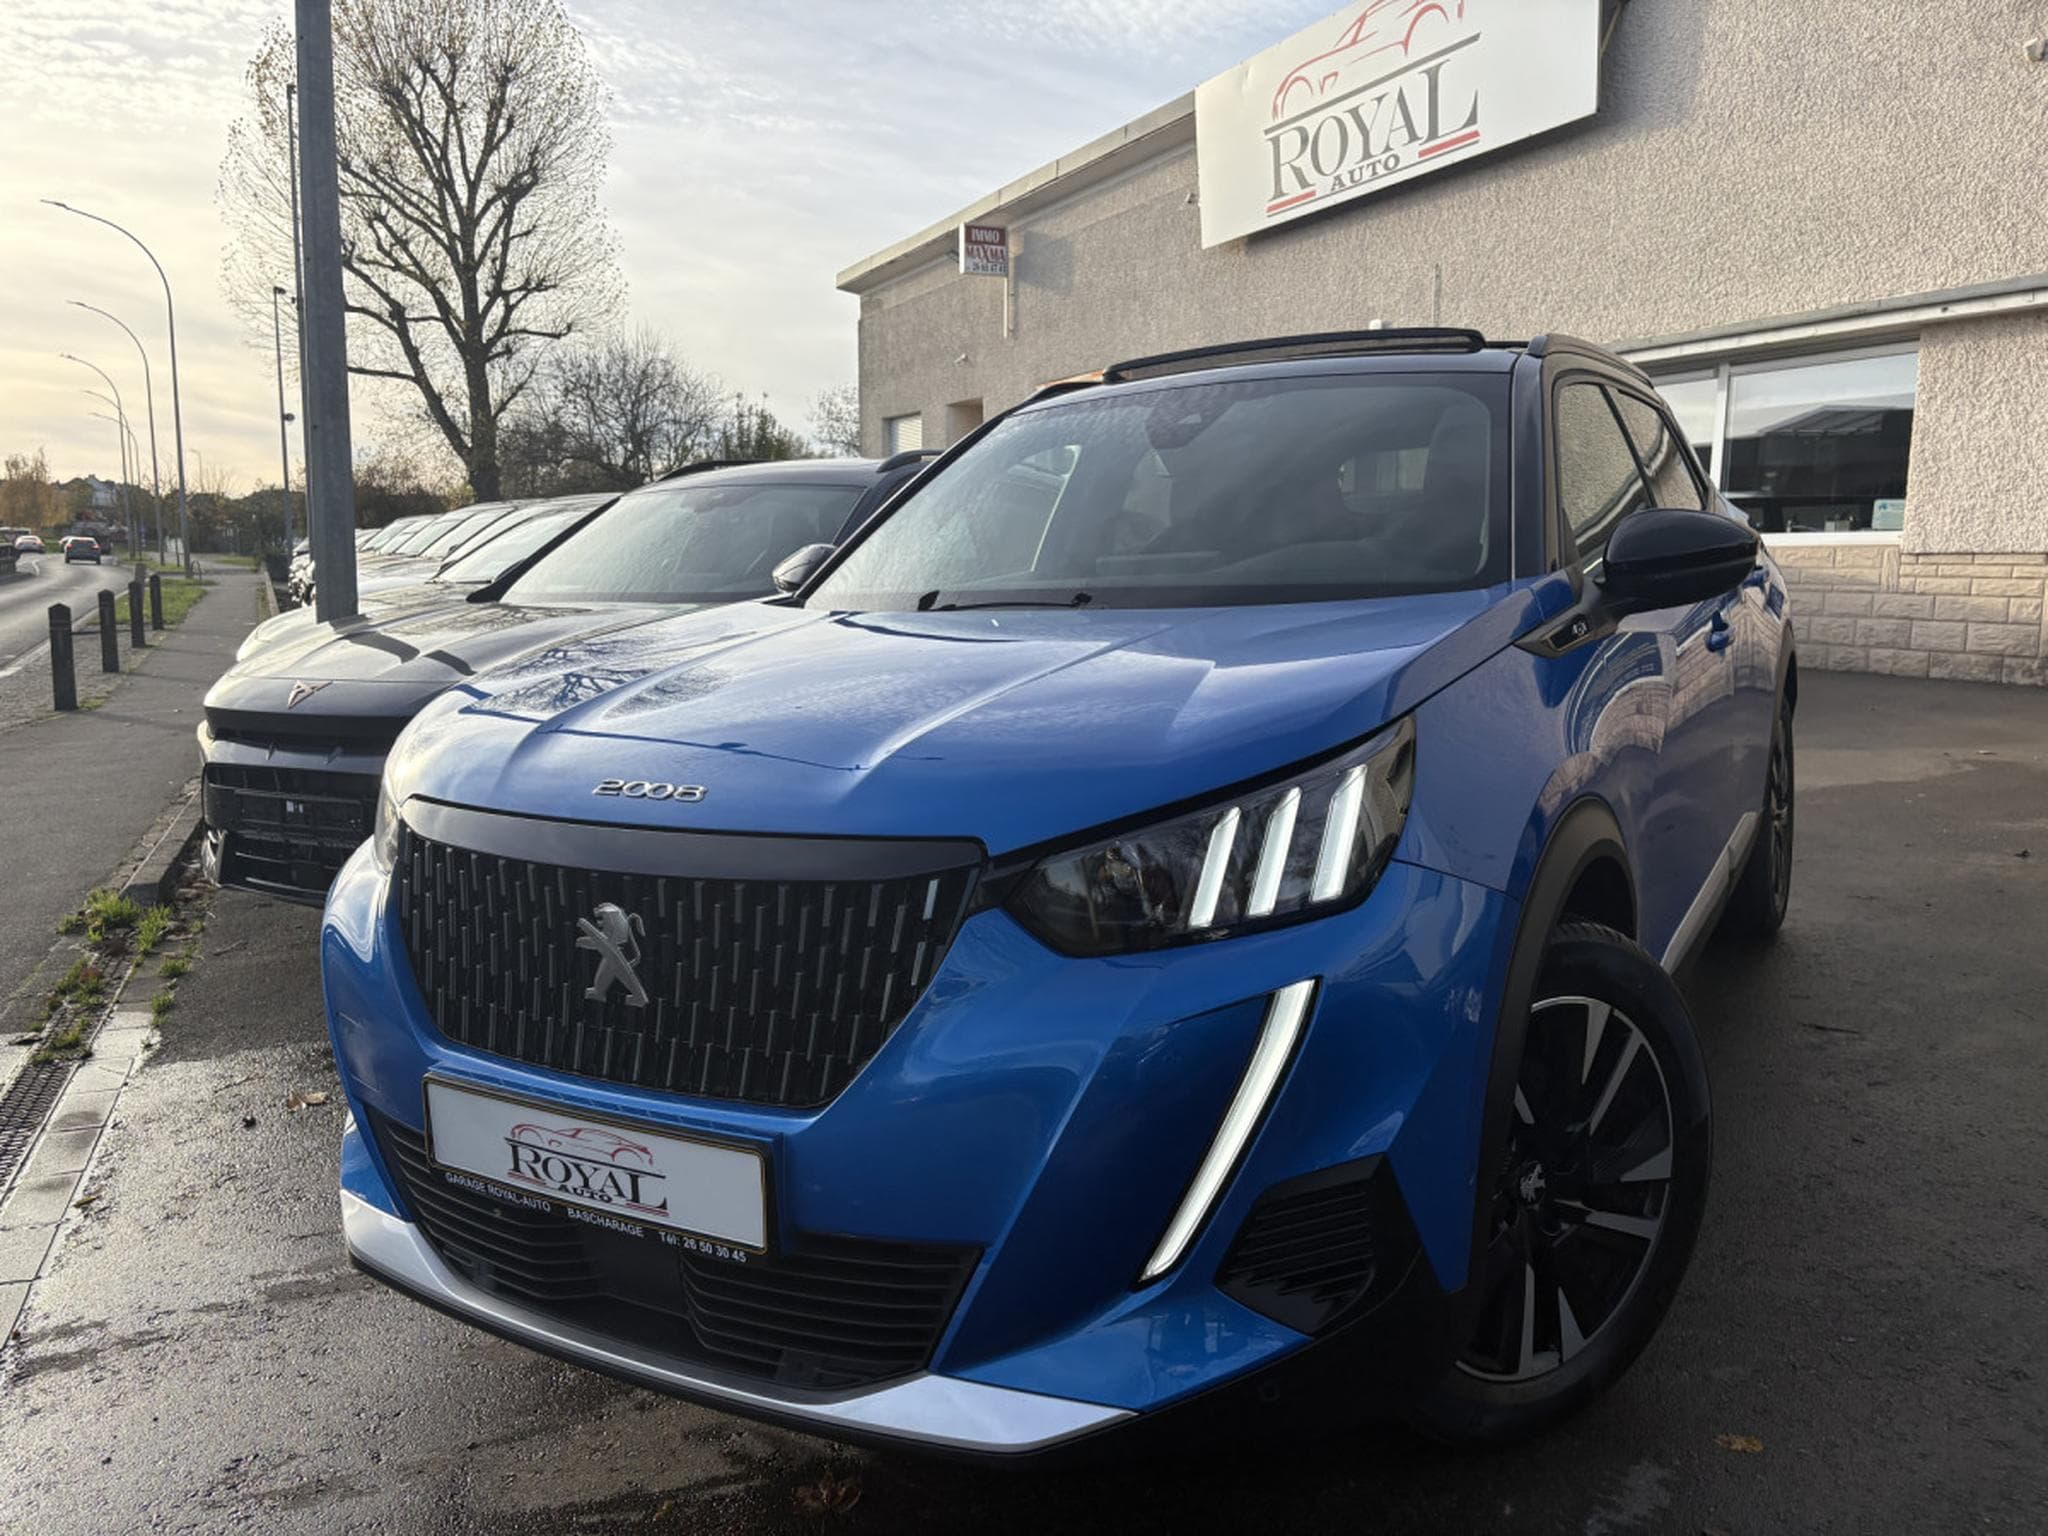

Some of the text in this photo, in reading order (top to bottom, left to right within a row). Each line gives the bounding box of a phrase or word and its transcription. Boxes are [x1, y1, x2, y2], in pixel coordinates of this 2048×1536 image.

[1268, 59, 1479, 202] ROYAL
[1330, 153, 1400, 193] AUTO
[971, 228, 1000, 243] IMMO
[592, 778, 708, 802] 2008
[510, 1143, 669, 1211] ROYAL
[557, 1184, 613, 1204] AUTO
[444, 1171, 487, 1194] GARAGE
[567, 1207, 645, 1238] BASCHARAGE
[698, 1241, 713, 1255] 50
[715, 1245, 730, 1259] 30
[731, 1248, 748, 1263] 45
